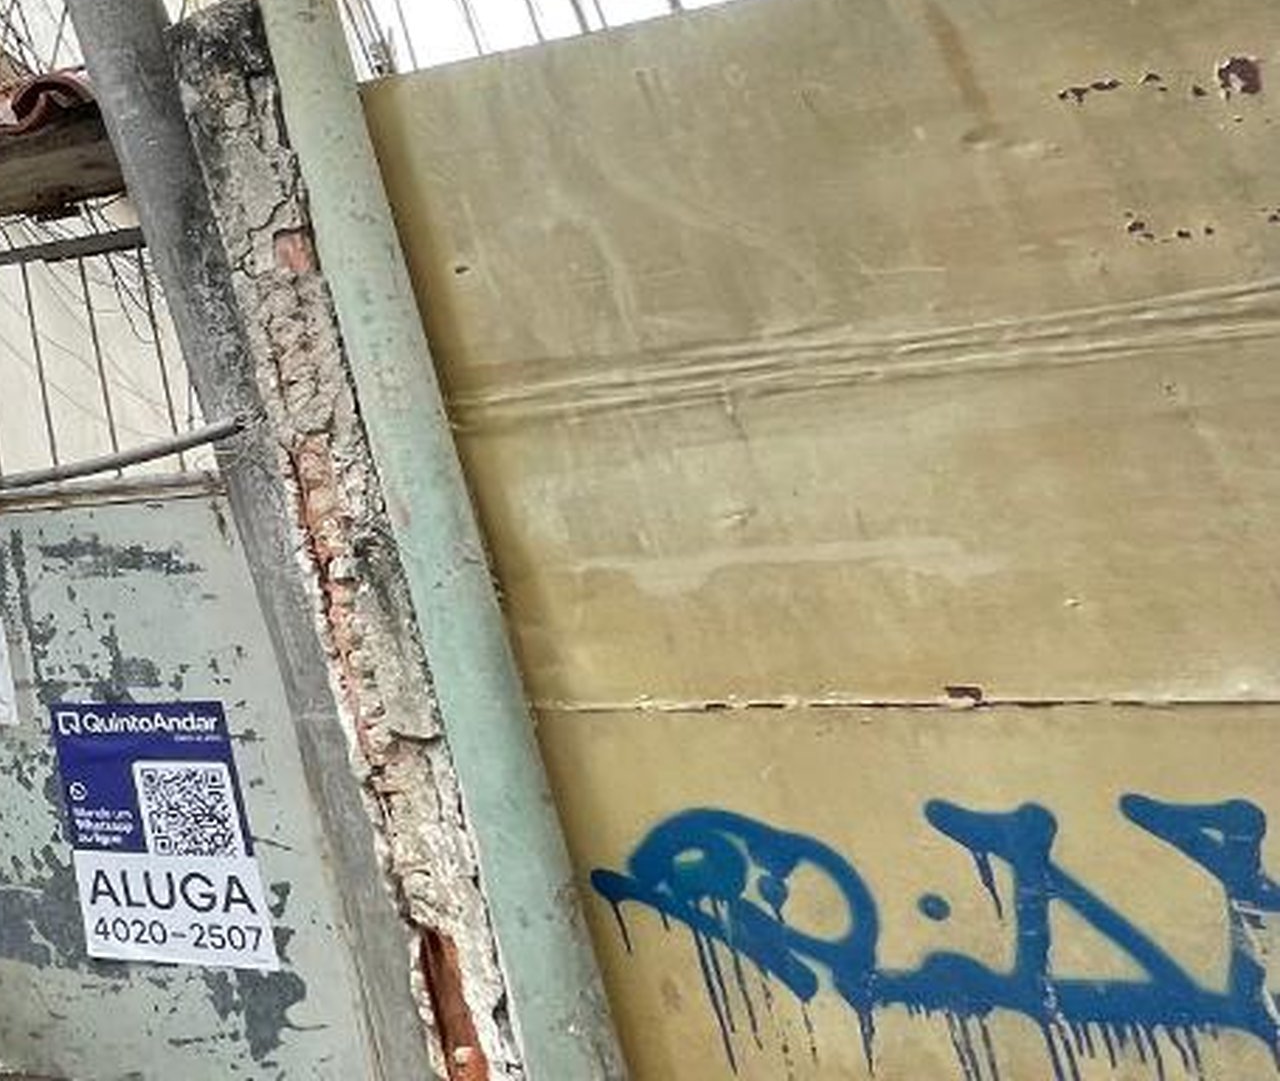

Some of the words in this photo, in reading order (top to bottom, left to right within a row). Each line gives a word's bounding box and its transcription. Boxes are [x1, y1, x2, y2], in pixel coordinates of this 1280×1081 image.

[82, 712, 218, 734] QuintoAndar
[90, 869, 258, 915] ALUGA
[94, 916, 263, 952] 4020-2507
